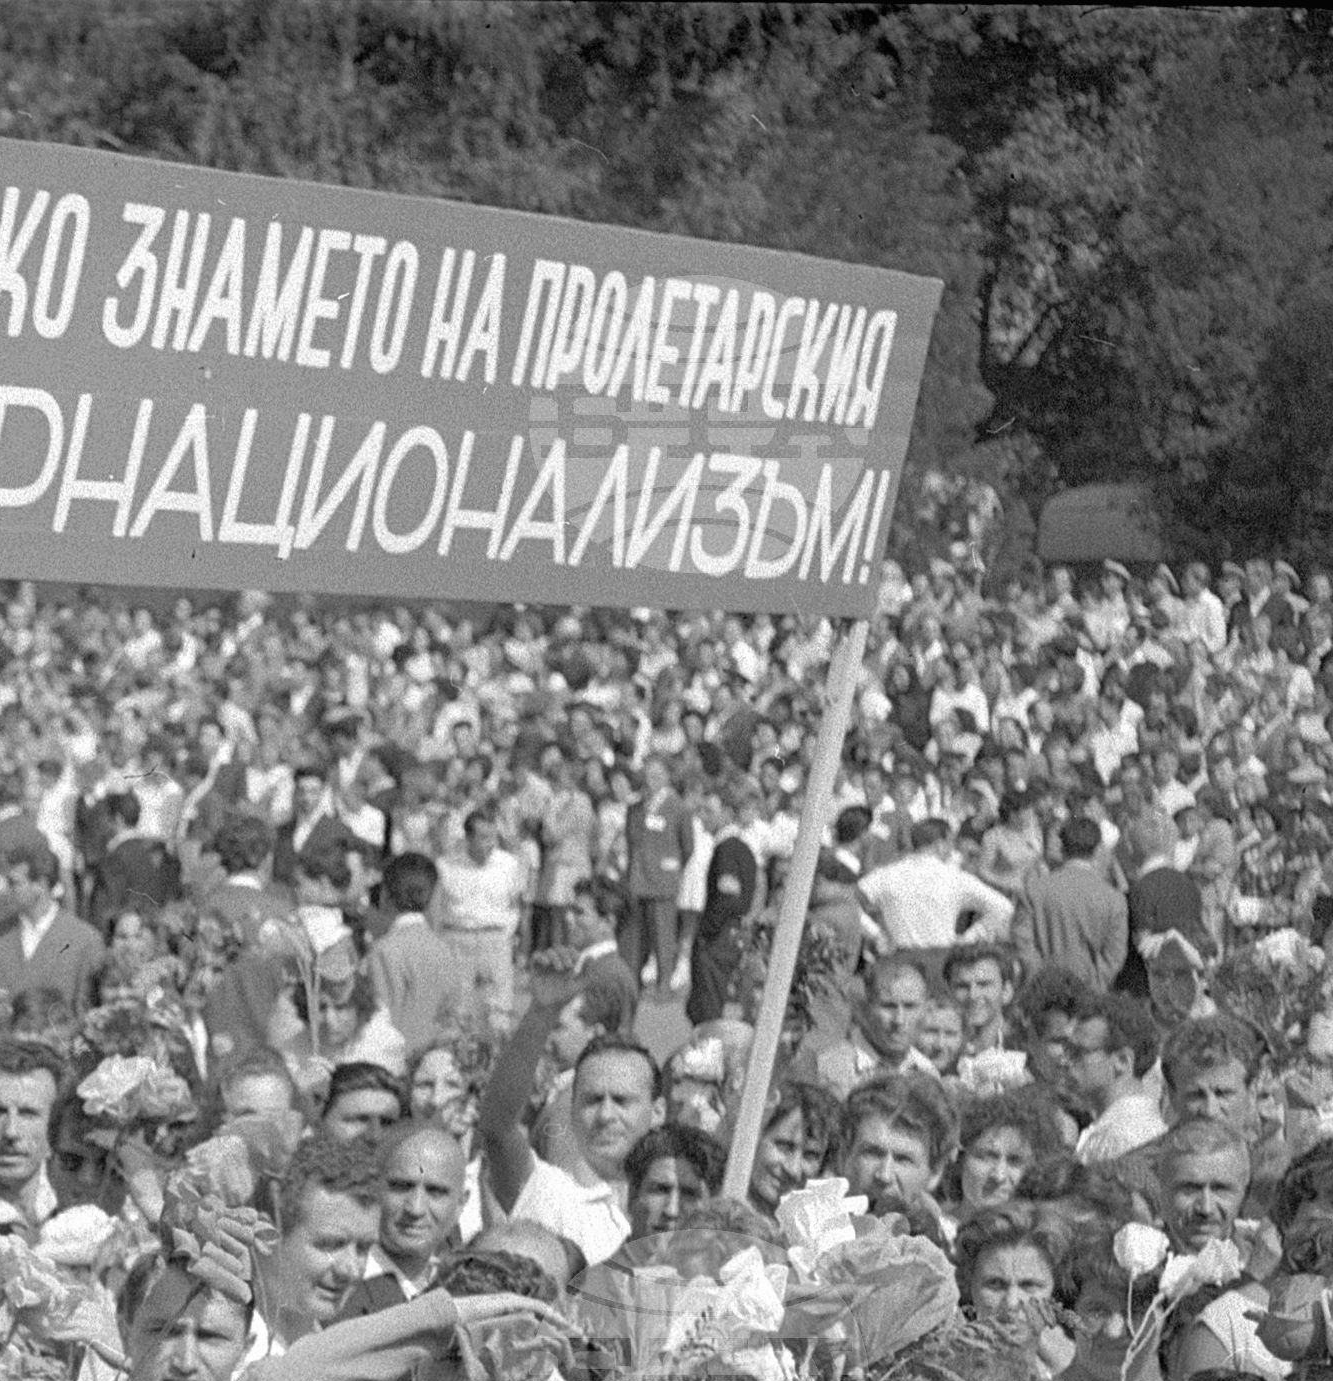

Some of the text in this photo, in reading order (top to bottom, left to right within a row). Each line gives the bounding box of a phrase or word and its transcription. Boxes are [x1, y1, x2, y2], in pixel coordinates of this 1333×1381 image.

[102, 200, 420, 375] ЗНАМЕТО
[421, 246, 507, 386] НА
[511, 257, 898, 429] ПРОЛЕТАРСКИЯ
